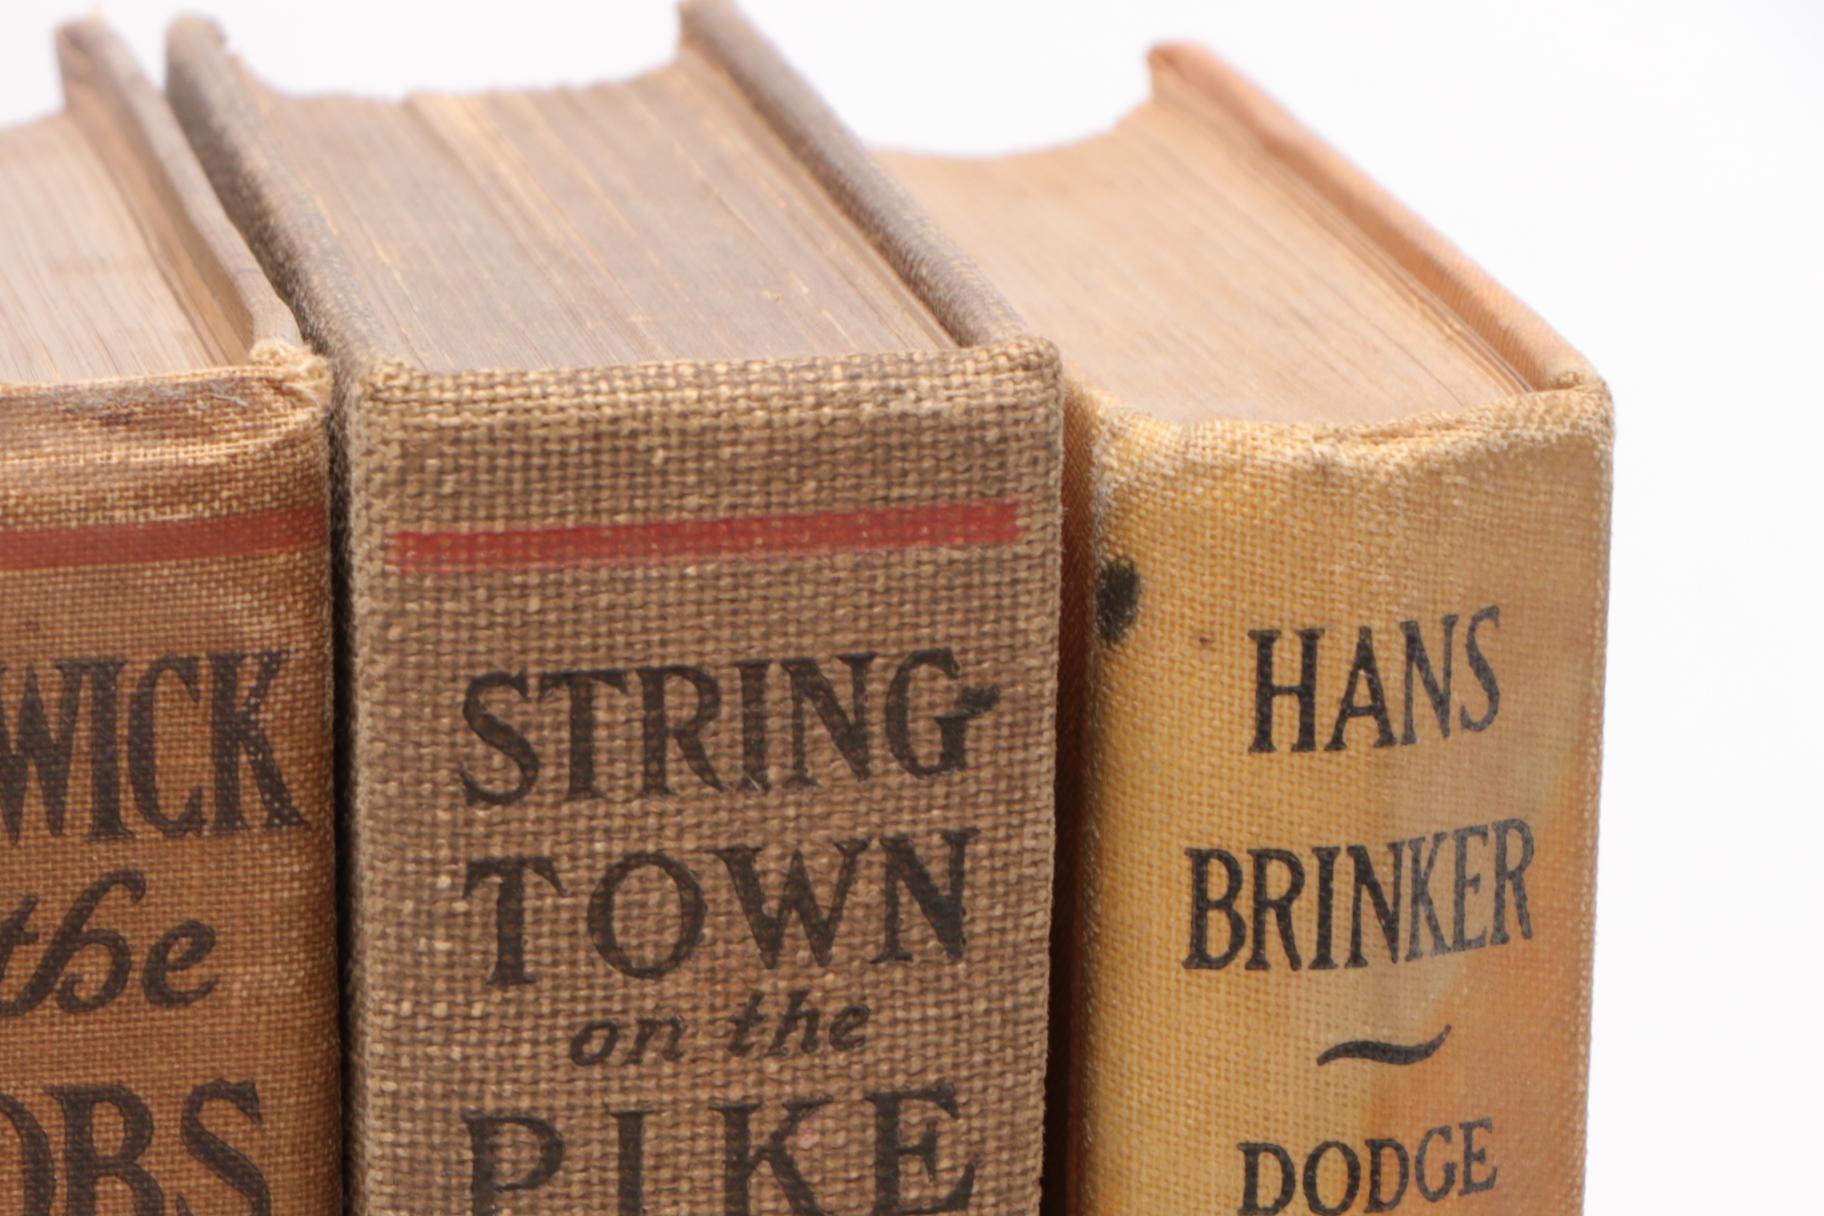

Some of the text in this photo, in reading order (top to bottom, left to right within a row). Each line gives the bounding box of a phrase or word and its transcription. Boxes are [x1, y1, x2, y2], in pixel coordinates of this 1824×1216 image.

[456, 647, 1001, 805] STRING
[1247, 605, 1501, 754] HANS
[462, 827, 981, 985] TOWN
[1182, 818, 1535, 971] BRINKER
[570, 988, 871, 1066] on the
